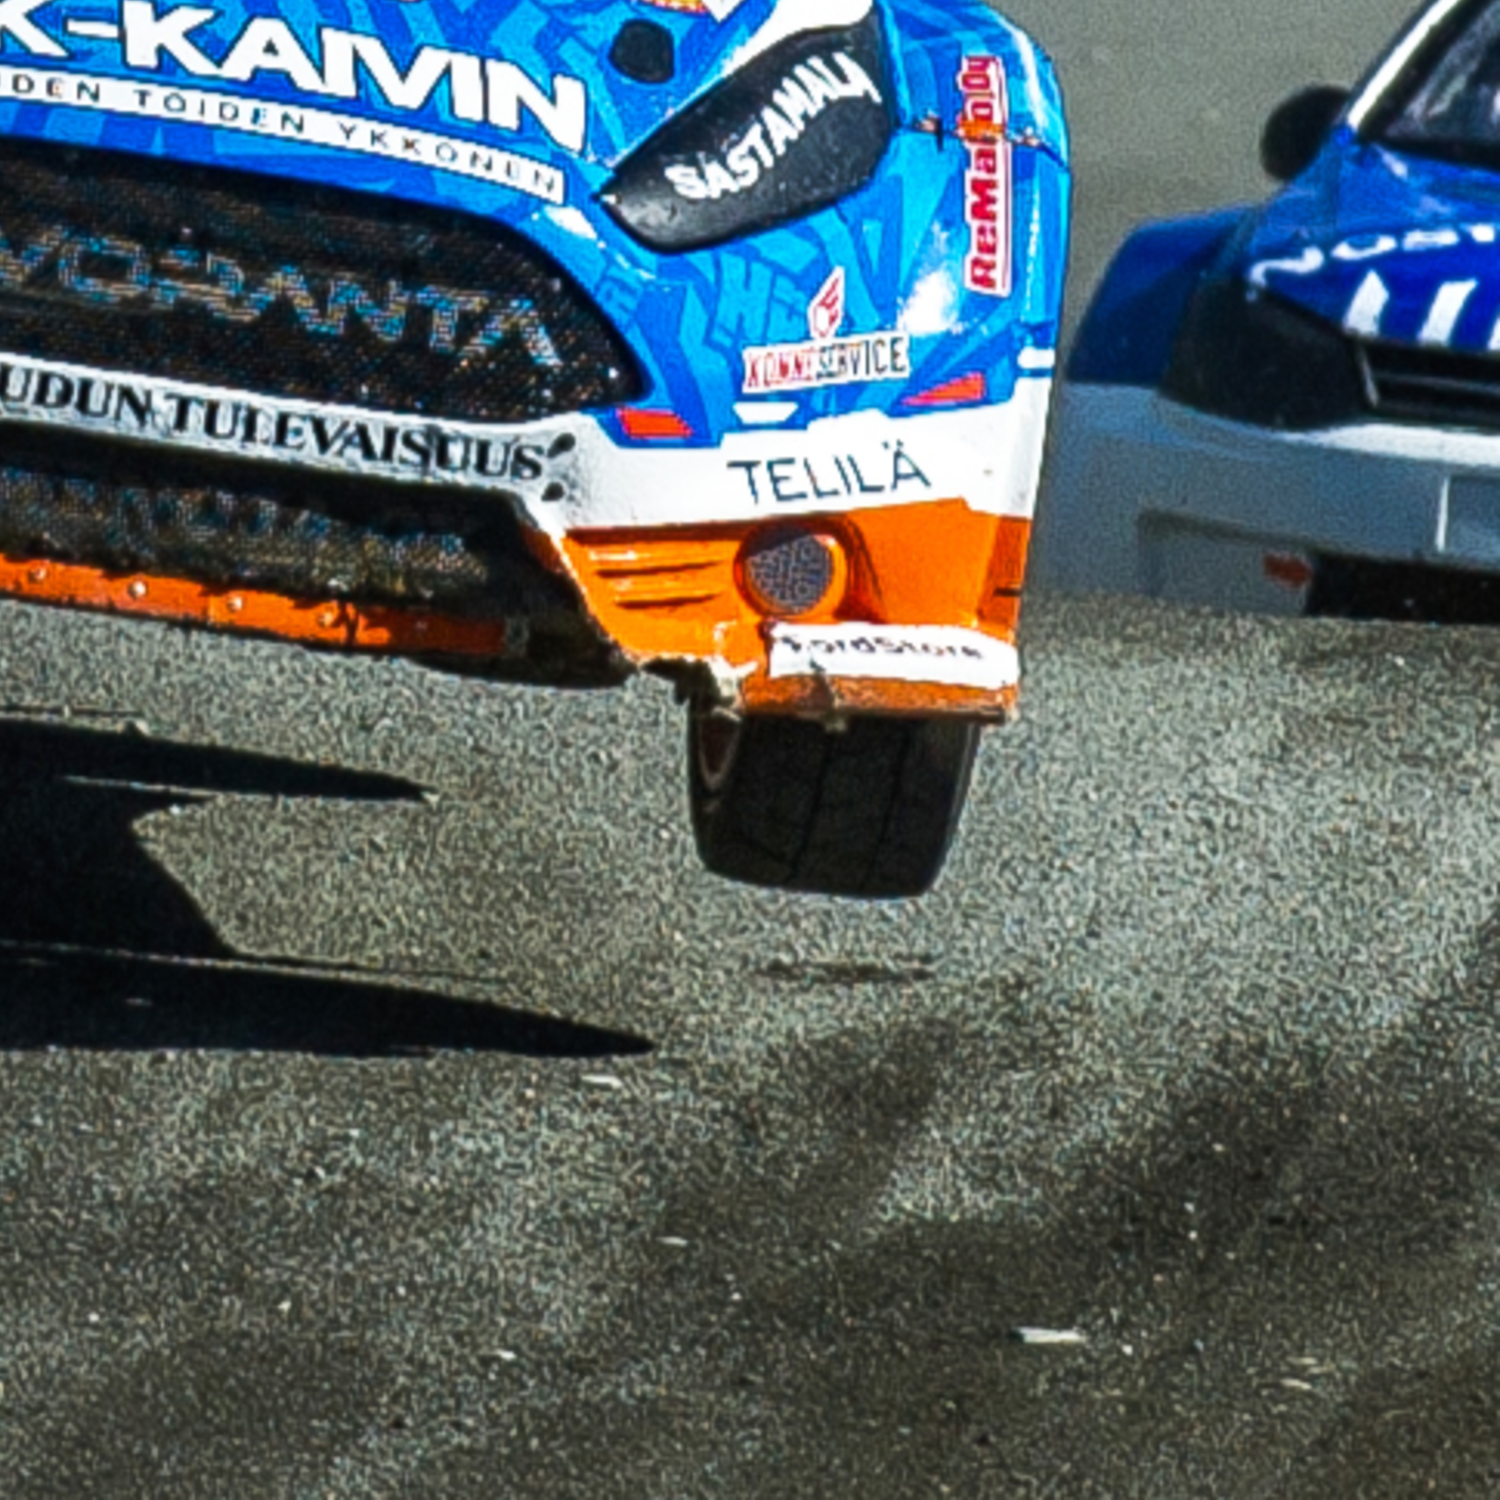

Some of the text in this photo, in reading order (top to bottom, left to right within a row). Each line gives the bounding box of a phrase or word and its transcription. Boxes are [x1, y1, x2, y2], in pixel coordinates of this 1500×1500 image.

[663, 51, 883, 200] SASTAMALA
[167, 391, 545, 480] TULEVAISUUS
[727, 439, 932, 505] TELILÄ
